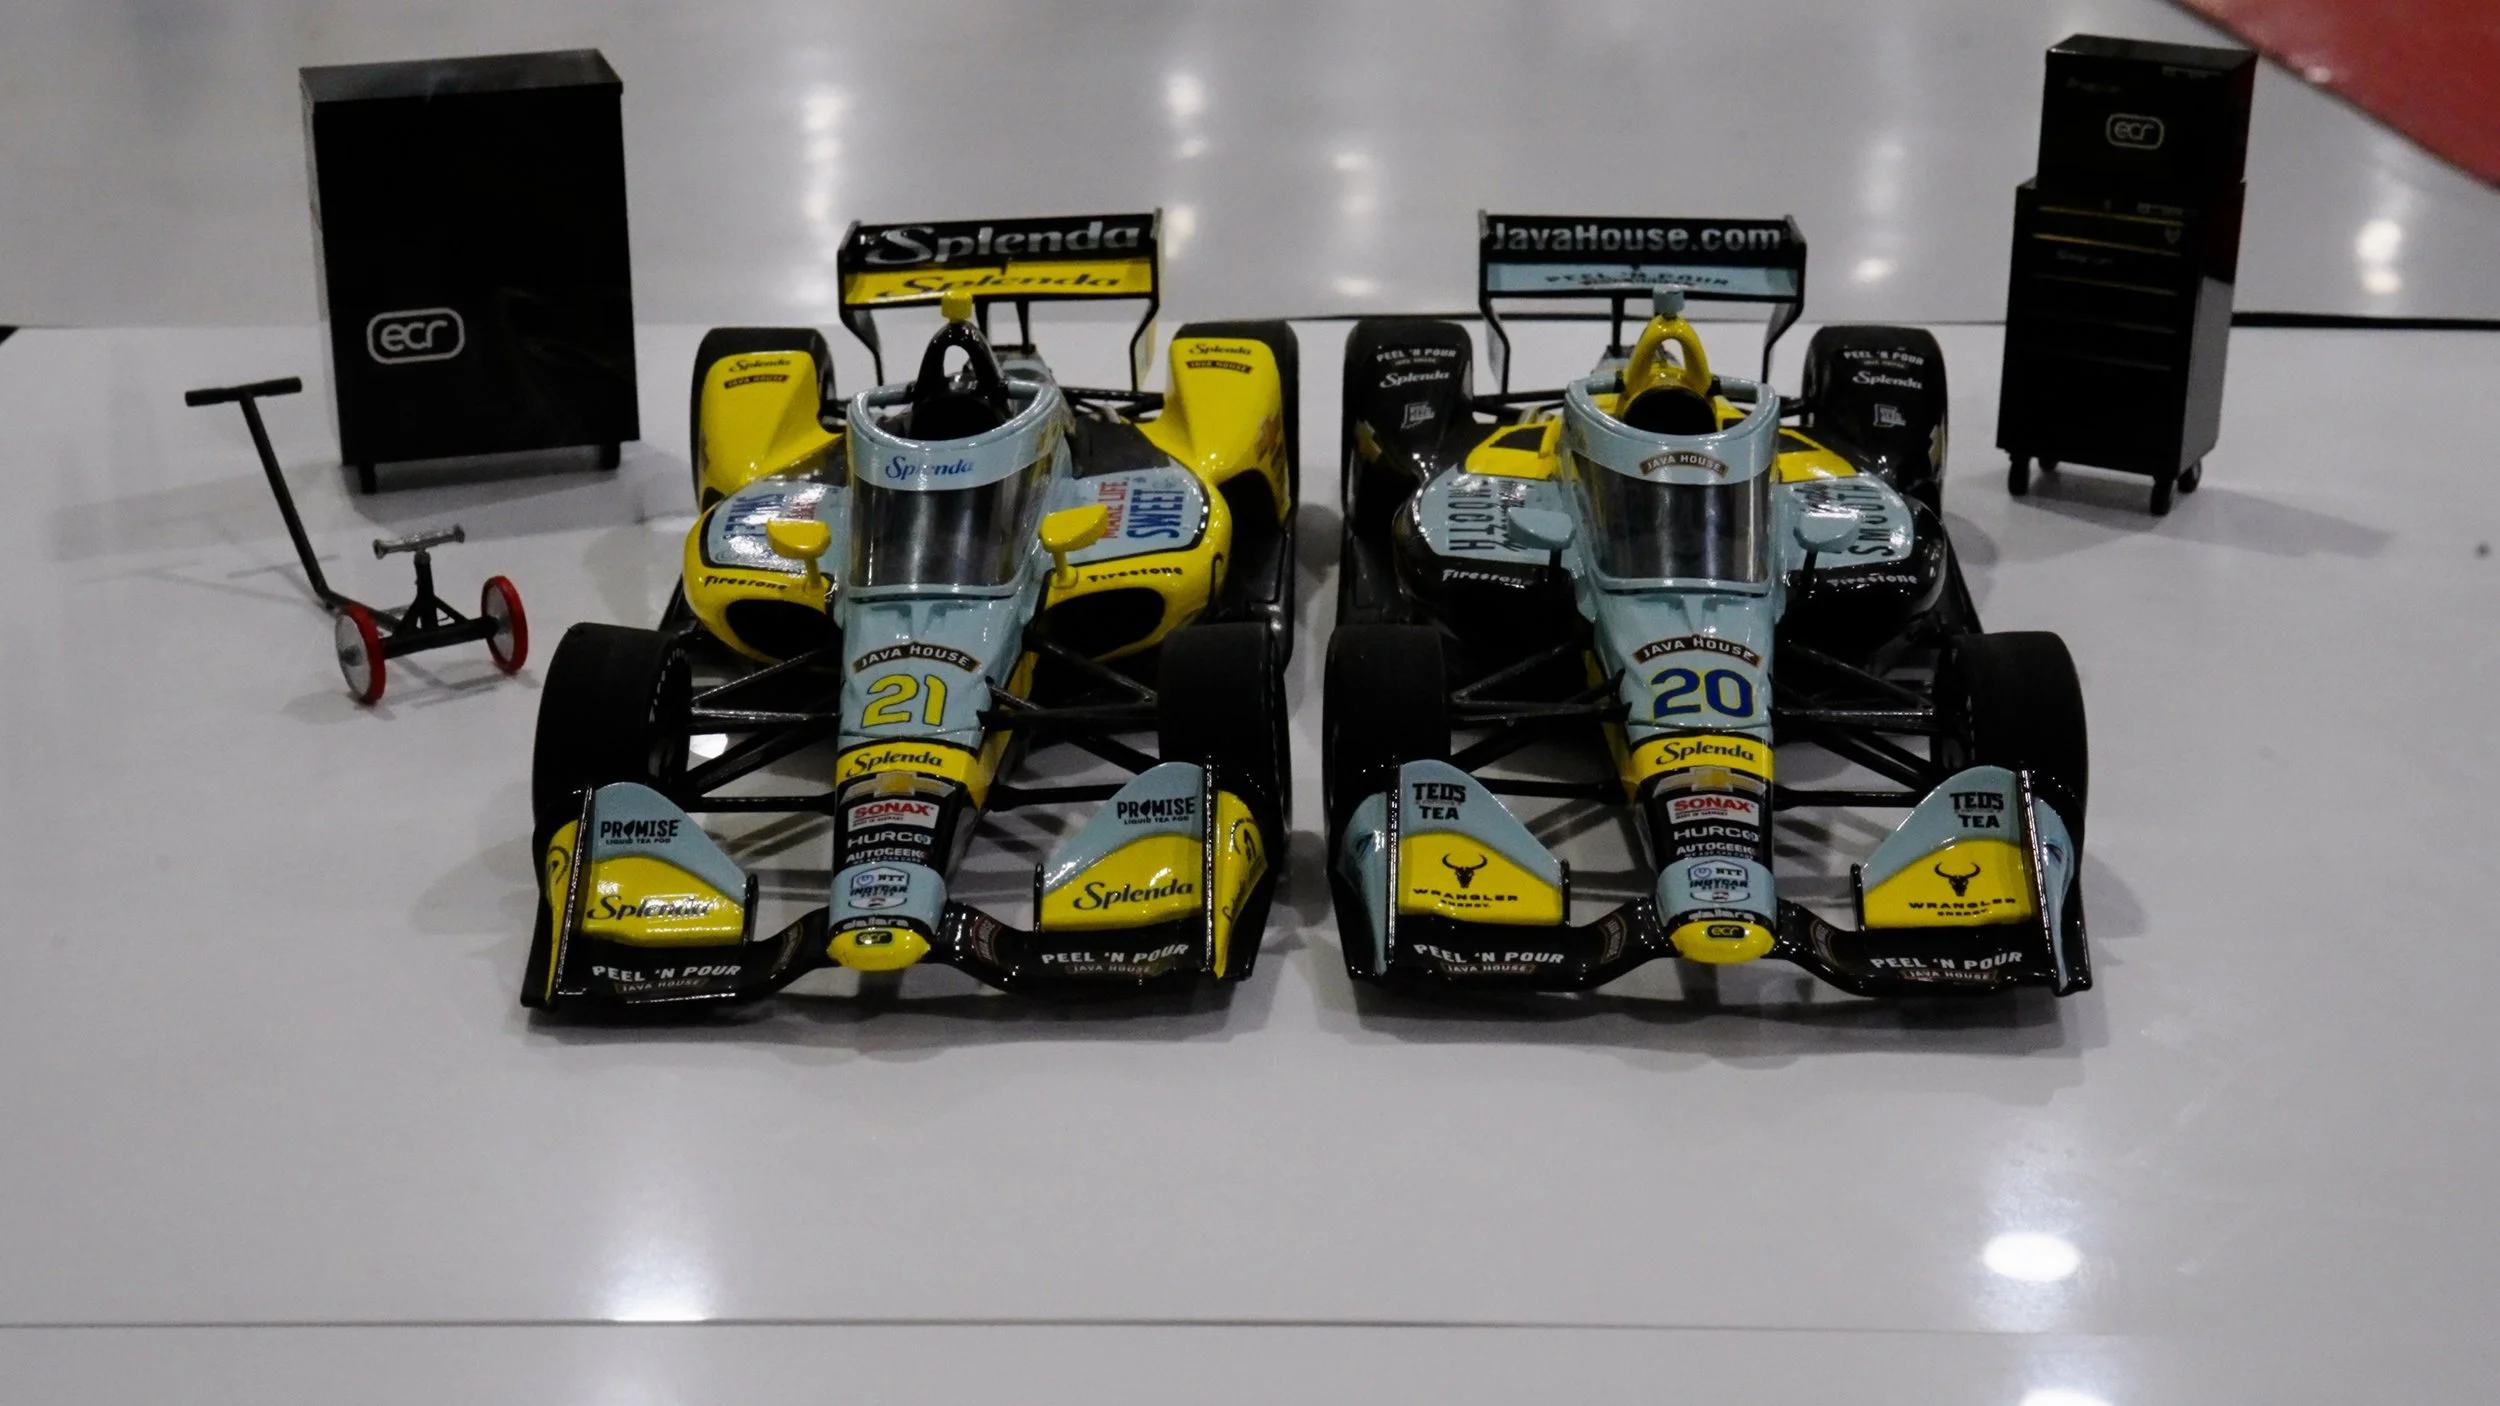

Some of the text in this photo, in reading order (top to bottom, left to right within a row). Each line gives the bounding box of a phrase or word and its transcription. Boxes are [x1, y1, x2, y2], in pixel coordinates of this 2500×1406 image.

[2114, 121, 2155, 140] ecr
[864, 220, 1141, 264] Splenda
[1492, 222, 1782, 251] JavaHouse.com
[876, 273, 1120, 298] Splenda
[380, 320, 449, 352] ecr
[1189, 343, 1252, 356] Splenda
[1376, 349, 1405, 361] PEEL
[729, 359, 792, 372] Splenda
[1379, 369, 1451, 389] Splenda
[1852, 370, 1923, 389] Splenda
[1647, 454, 1722, 472] JAVA HOUSE
[1126, 489, 1185, 539] SWEET
[704, 575, 788, 591] Firestone
[1086, 566, 1184, 583] Firestone
[1826, 574, 1918, 588] Firestone
[861, 644, 971, 667] JAVA HOUSE
[1644, 637, 1756, 661] JAVA HOUSE
[860, 673, 948, 729] 21
[1650, 666, 1756, 721] 20
[1655, 741, 1756, 766] Splenda
[845, 750, 943, 778] Splenda
[1412, 782, 1467, 804] TEDS
[1949, 791, 2005, 811] TEDS
[853, 802, 930, 820] SONAX
[1116, 796, 1199, 819] PROMISE
[1418, 804, 1460, 820] TEA
[1674, 796, 1752, 813] SONAX
[600, 818, 682, 839] PROMISE
[1957, 814, 2001, 828] TEA
[847, 830, 933, 849] HURCO
[1674, 825, 1760, 843] HURCO
[846, 847, 925, 863] AUTOGEEK
[1676, 842, 1755, 856] AUTOGEEK
[877, 873, 905, 882] NTT
[1715, 867, 1743, 876] NTT
[1072, 877, 1195, 911] Splenda
[1412, 887, 1519, 902] WRANGLER
[1908, 897, 2017, 909] WRANGLER
[586, 894, 711, 921] Splenda
[1711, 926, 1740, 937] ecr
[1041, 944, 1190, 965] PEEL 'N POUR
[1413, 944, 1566, 964] PEEL 'N POUR
[1869, 951, 2023, 970] PEEL 'N POUR
[591, 964, 742, 982] PEEL 'N POUR
[1072, 963, 1151, 974] JAVA HOUSE
[1448, 963, 1528, 973] JAVA HOUSE
[1909, 969, 1990, 981] JAVA HOUSE
[622, 977, 702, 992] JAVA HOUSE
